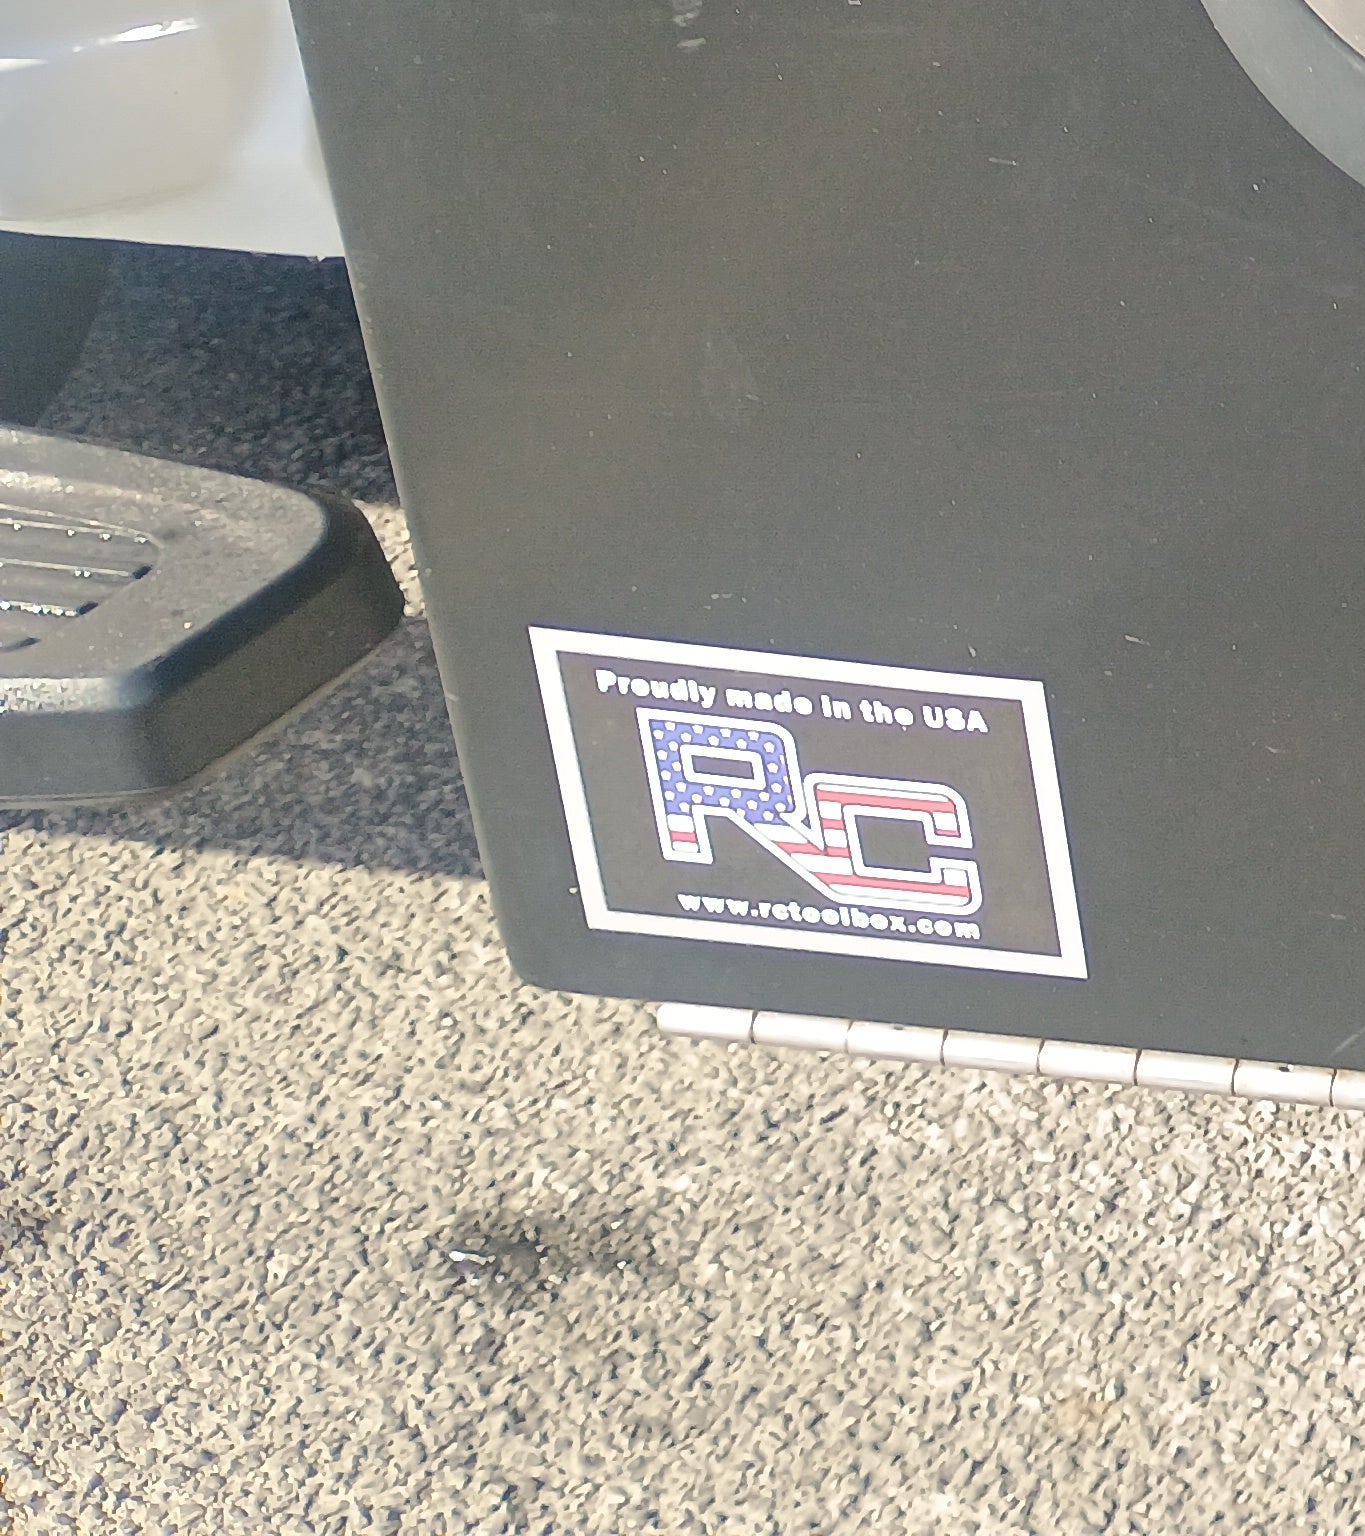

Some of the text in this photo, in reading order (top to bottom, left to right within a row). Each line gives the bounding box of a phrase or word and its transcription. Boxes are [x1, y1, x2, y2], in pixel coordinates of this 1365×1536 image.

[595, 669, 988, 733] Proudly made in the USA
[636, 707, 983, 916] RC
[677, 893, 981, 940] www.rctoolbox.com
